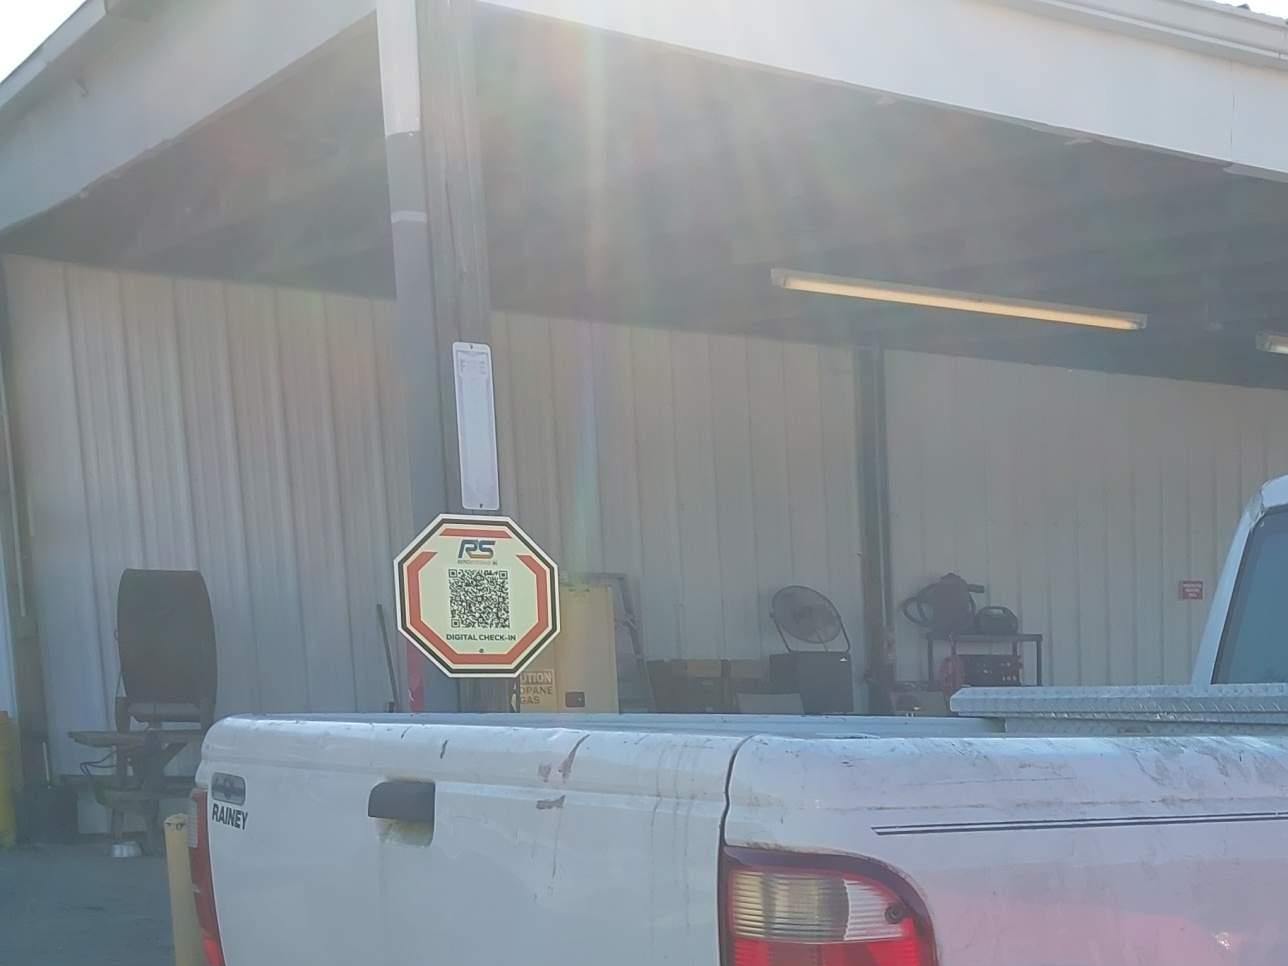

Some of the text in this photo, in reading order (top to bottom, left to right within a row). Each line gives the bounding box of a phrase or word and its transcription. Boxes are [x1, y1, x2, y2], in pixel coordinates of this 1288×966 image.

[520, 672, 552, 684] UTION
[520, 686, 552, 696] OPANE
[212, 803, 248, 830] RAINEY
